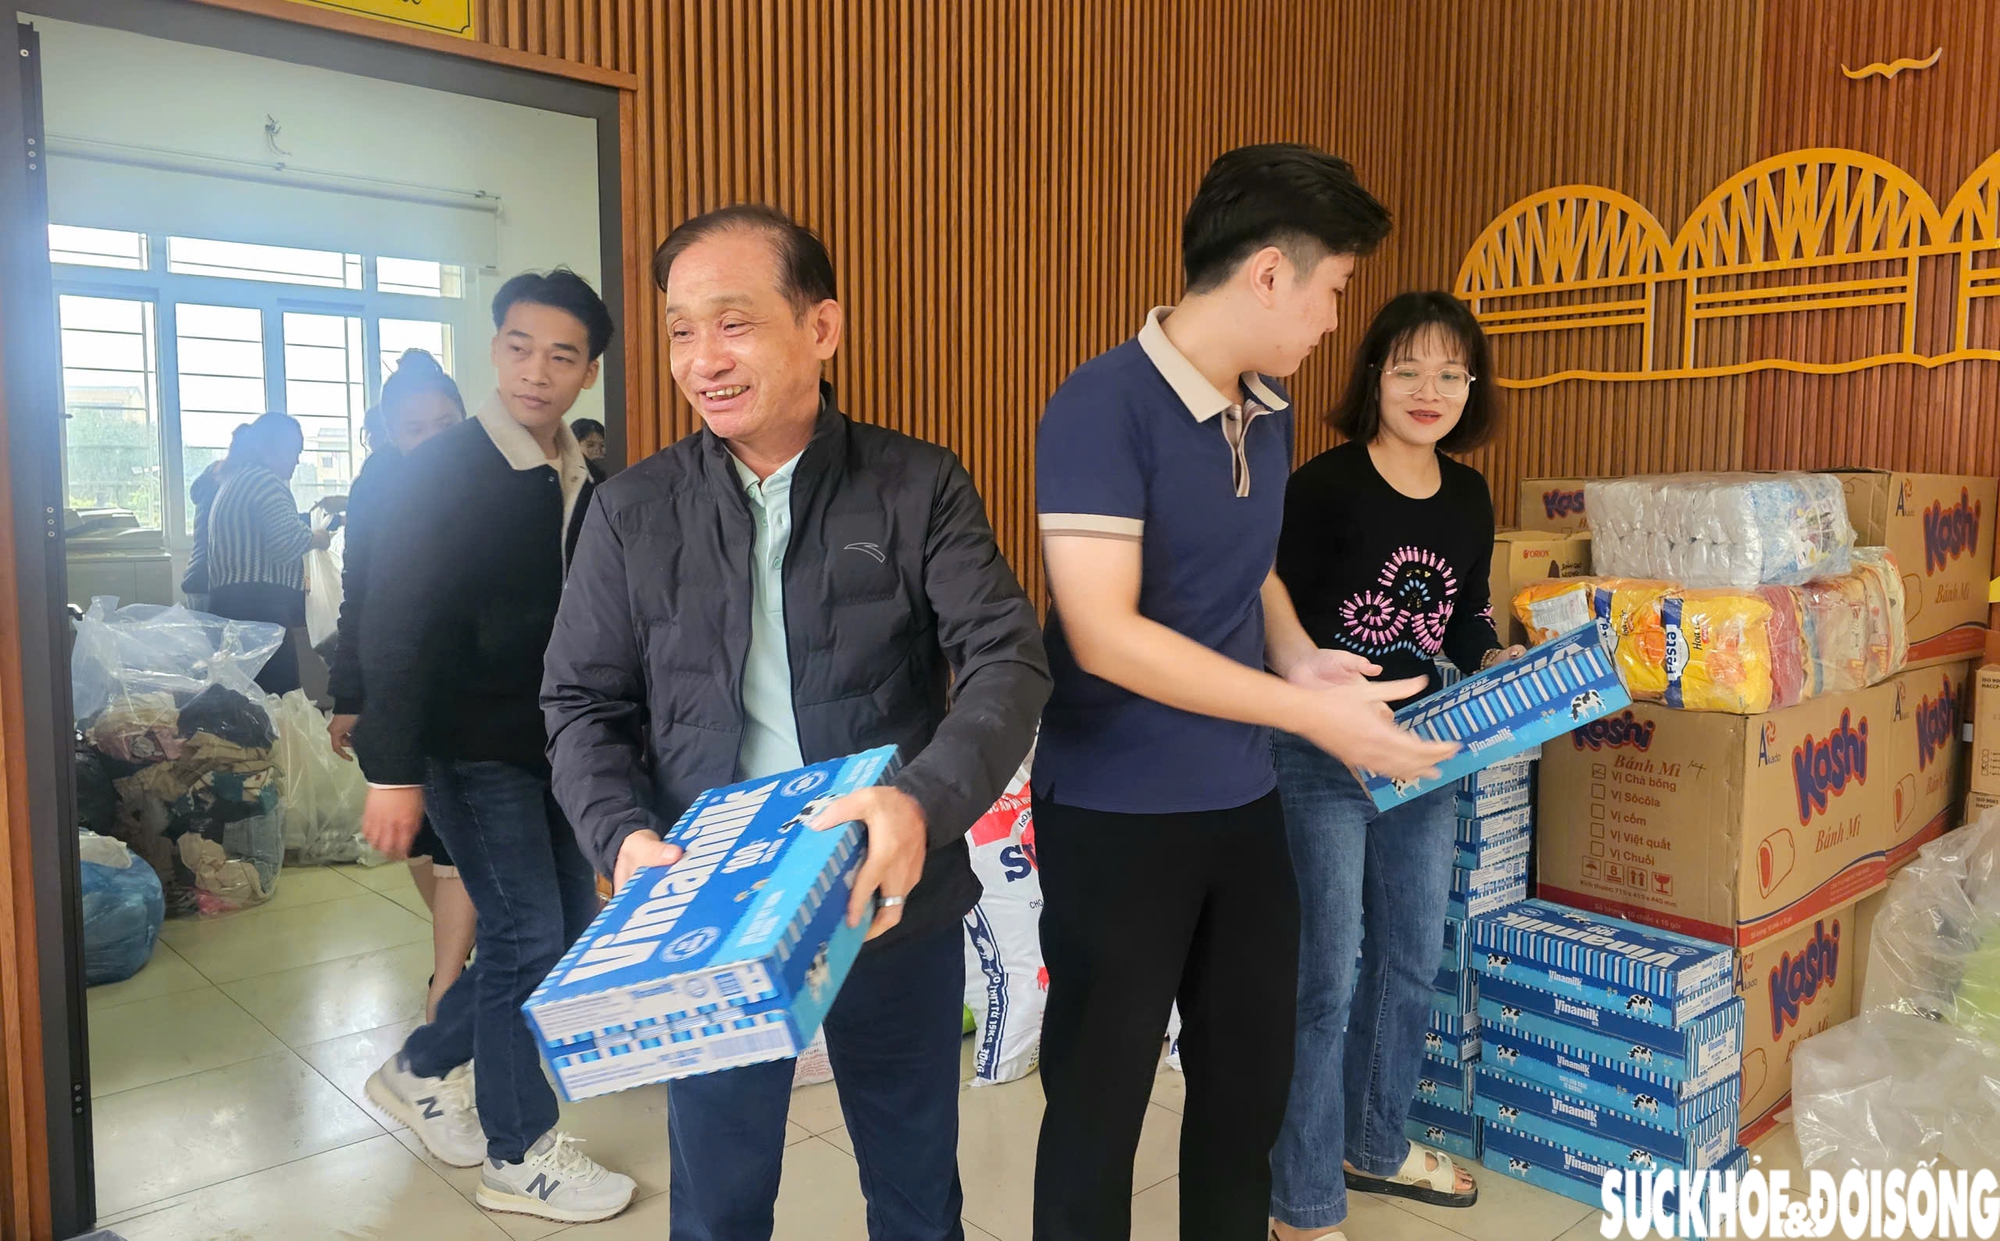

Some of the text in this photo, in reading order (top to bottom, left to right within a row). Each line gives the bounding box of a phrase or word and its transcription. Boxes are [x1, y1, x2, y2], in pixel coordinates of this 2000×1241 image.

[1543, 489, 1585, 520] Kas
[1923, 486, 1981, 577] Kashi
[1399, 643, 1585, 731] Vinamil
[1572, 710, 1656, 752] Kashi
[1916, 674, 1963, 772] Kashi
[1467, 728, 1514, 753] Vinamilk
[1758, 723, 1781, 767] Akado
[1613, 754, 1682, 778] Bánh Mì
[1792, 707, 1868, 826] Kashi
[1612, 771, 1677, 792] Vị Chà bông
[1611, 790, 1660, 807] Vị Sôcôla
[1610, 810, 1647, 826] Vị cốm
[1610, 829, 1671, 850] Vị Việt quất
[1815, 814, 1861, 853] Bánh Mì
[1610, 848, 1655, 866] Vị Chuối
[559, 780, 781, 987] Vinamilk
[1610, 866, 1618, 876] 8
[1496, 912, 1680, 968] Vinamilk
[1549, 970, 1582, 986] Vinamilk
[1768, 918, 1840, 1042] Kashi
[1554, 999, 1599, 1022] Vinamilk
[1557, 1055, 1590, 1074] Vinamilk
[417, 1096, 444, 1120] N
[1552, 1098, 1597, 1123] Vinamilk
[1564, 1153, 1607, 1177] Vinamil
[525, 1172, 561, 1201] N
